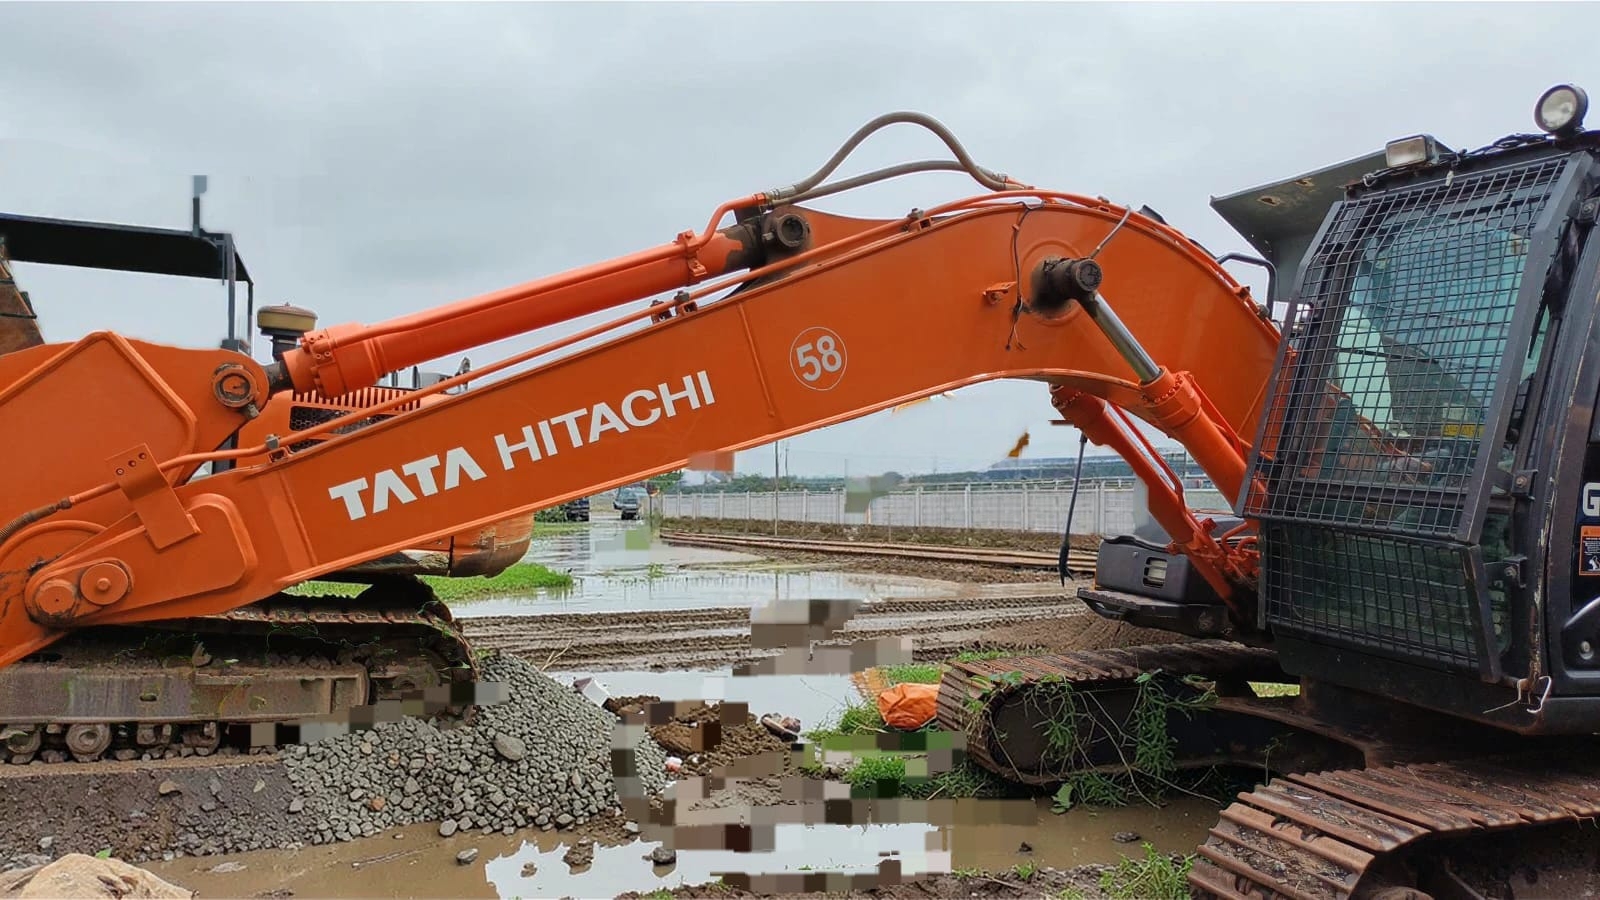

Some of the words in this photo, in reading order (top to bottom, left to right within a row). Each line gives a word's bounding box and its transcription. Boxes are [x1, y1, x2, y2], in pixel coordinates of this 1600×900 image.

[796, 335, 842, 382] 58
[328, 446, 487, 521] TATA
[494, 370, 715, 471] HITACHI
